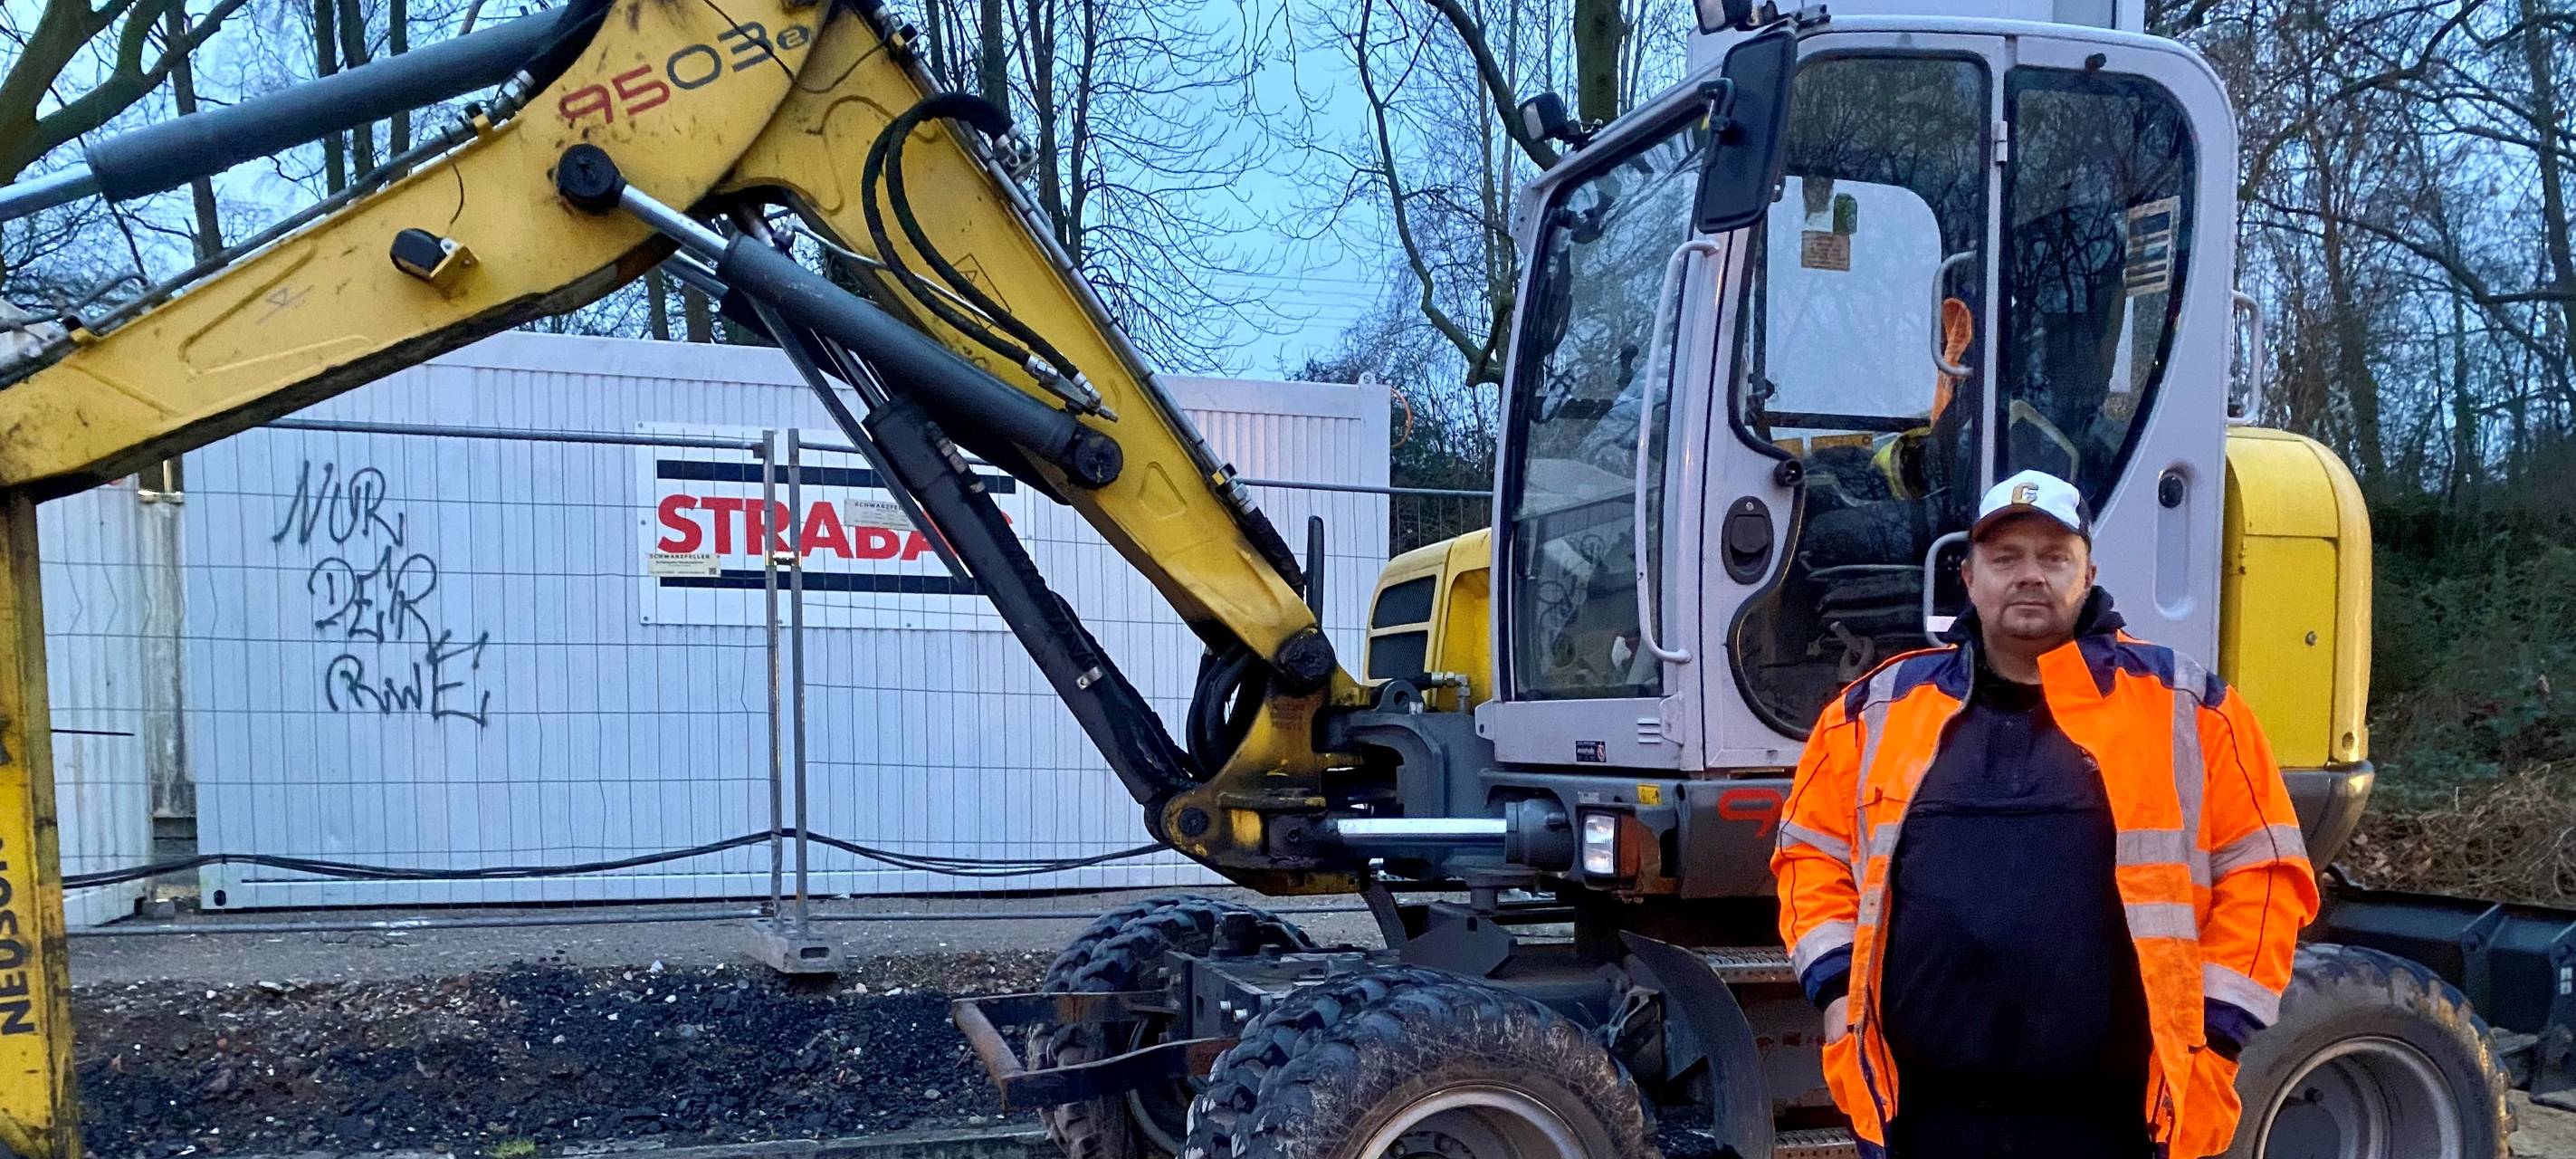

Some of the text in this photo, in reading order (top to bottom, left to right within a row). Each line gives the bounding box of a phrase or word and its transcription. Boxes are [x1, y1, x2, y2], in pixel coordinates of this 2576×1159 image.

[558, 22, 774, 125] 9503
[272, 459, 404, 547] NUR
[657, 493, 1013, 562] STRAB
[307, 544, 437, 646] DER
[326, 629, 490, 727] RWE
[0, 838, 35, 1036] NEUS
